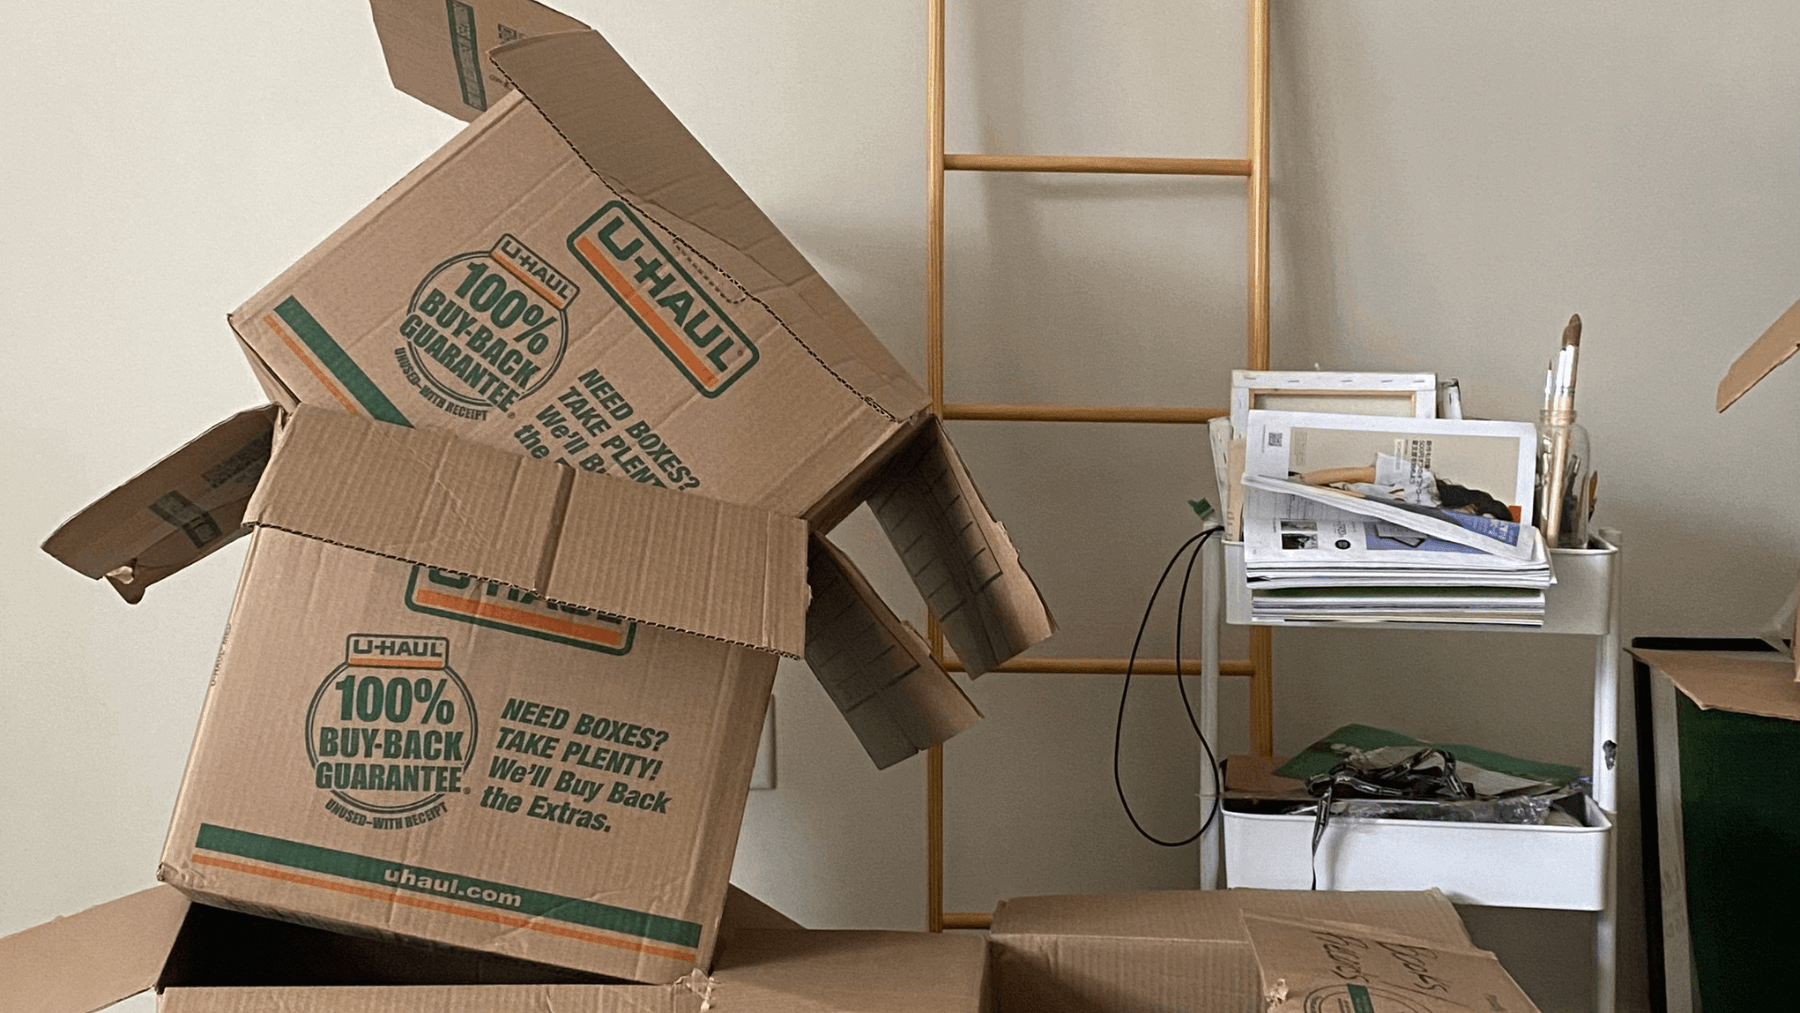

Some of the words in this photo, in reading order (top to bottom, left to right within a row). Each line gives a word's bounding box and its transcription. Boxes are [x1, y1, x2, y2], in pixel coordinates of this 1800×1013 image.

[500, 240, 569, 300] U-HAUL
[597, 215, 737, 372] U-HAUL
[454, 262, 557, 355] 100%
[400, 314, 521, 413] GUARANTEE
[419, 288, 541, 390] BUY-BACK
[445, 401, 488, 421] RECEIPT
[536, 405, 590, 456] We'll
[578, 368, 634, 421] NEED
[625, 420, 701, 491] BOXES?
[513, 424, 550, 460] the
[558, 386, 612, 437] TAKE
[601, 435, 668, 489] PLEN
[353, 639, 443, 657] U-HAUL
[335, 675, 455, 725] 100%
[500, 698, 570, 730] NEED
[573, 713, 669, 752] BOXES?
[319, 727, 464, 761] BUY-BACK
[496, 726, 561, 759] TAKE
[560, 740, 663, 781] PLENTY!
[315, 761, 462, 792] GUARANTEE
[488, 755, 552, 788] We'll
[553, 770, 605, 803] Buy
[607, 781, 672, 814] Back
[404, 801, 448, 828] RECEIPT
[480, 785, 523, 813] the
[527, 795, 611, 833] Extras.
[383, 867, 523, 908] uhaul.com
